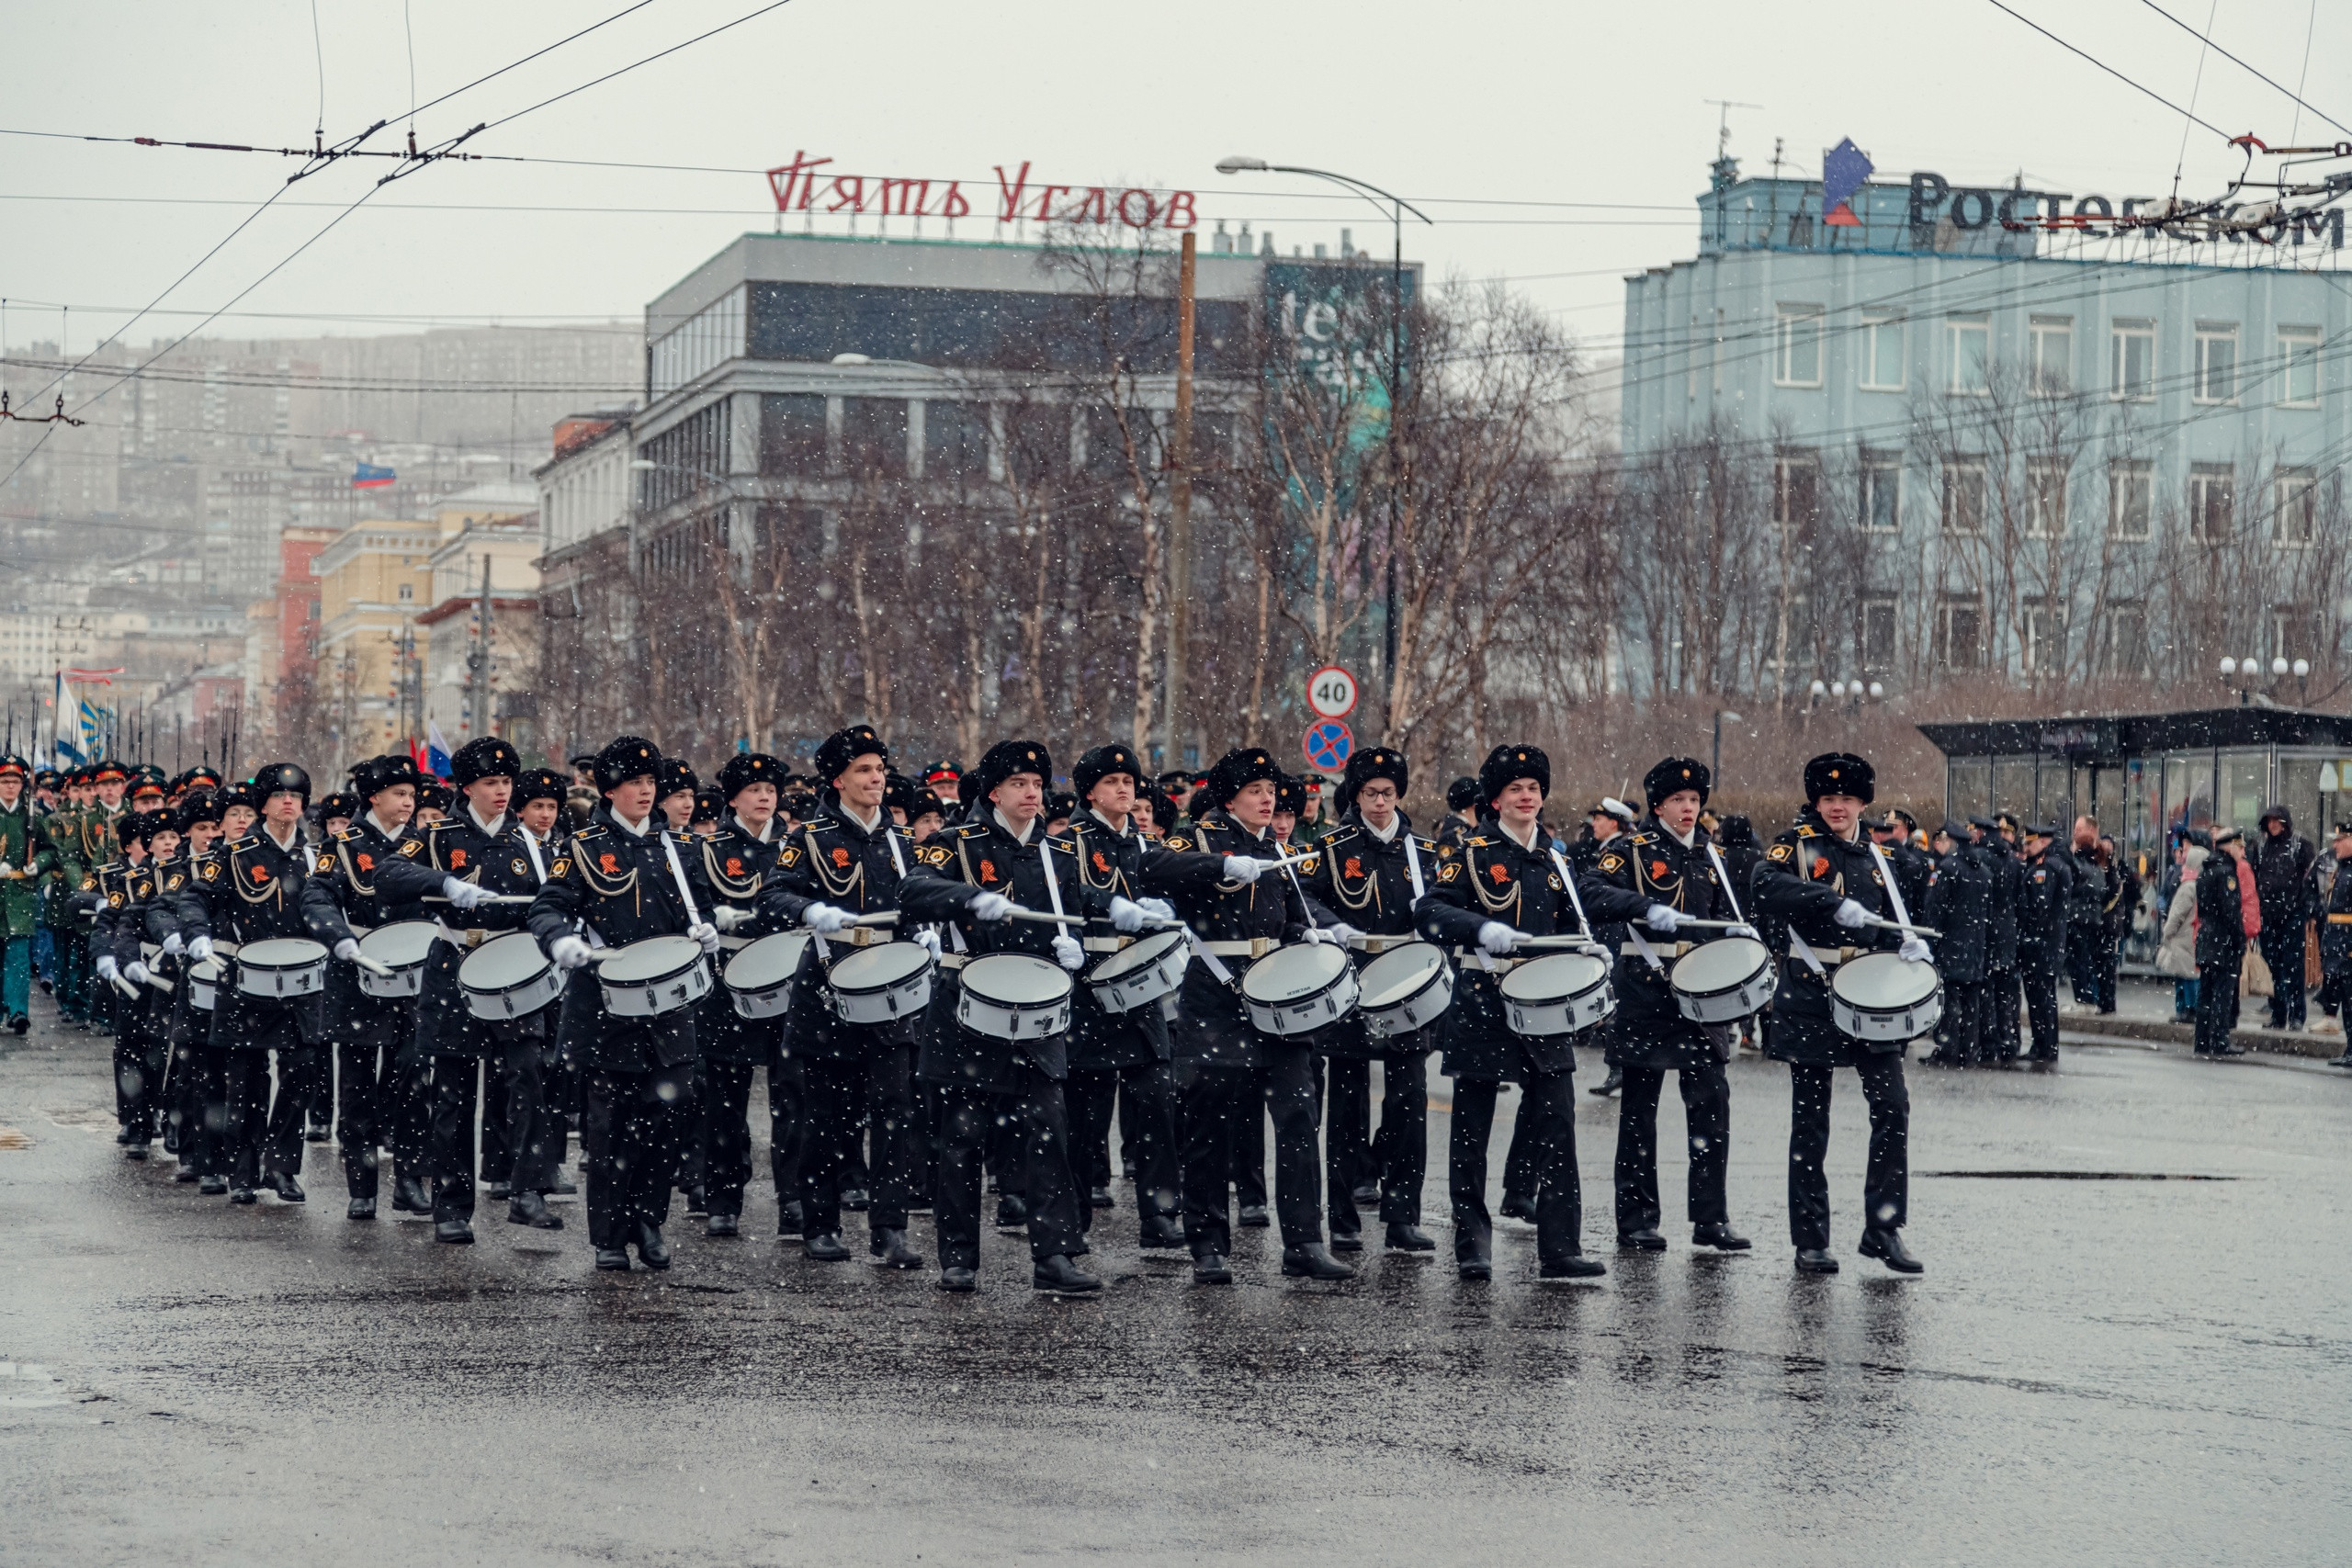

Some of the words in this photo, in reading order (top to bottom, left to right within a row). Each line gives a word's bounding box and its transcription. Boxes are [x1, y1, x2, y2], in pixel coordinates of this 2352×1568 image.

[766, 150, 969, 217] Пять
[993, 160, 1196, 230] Углов
[1317, 683, 1346, 702] 40
